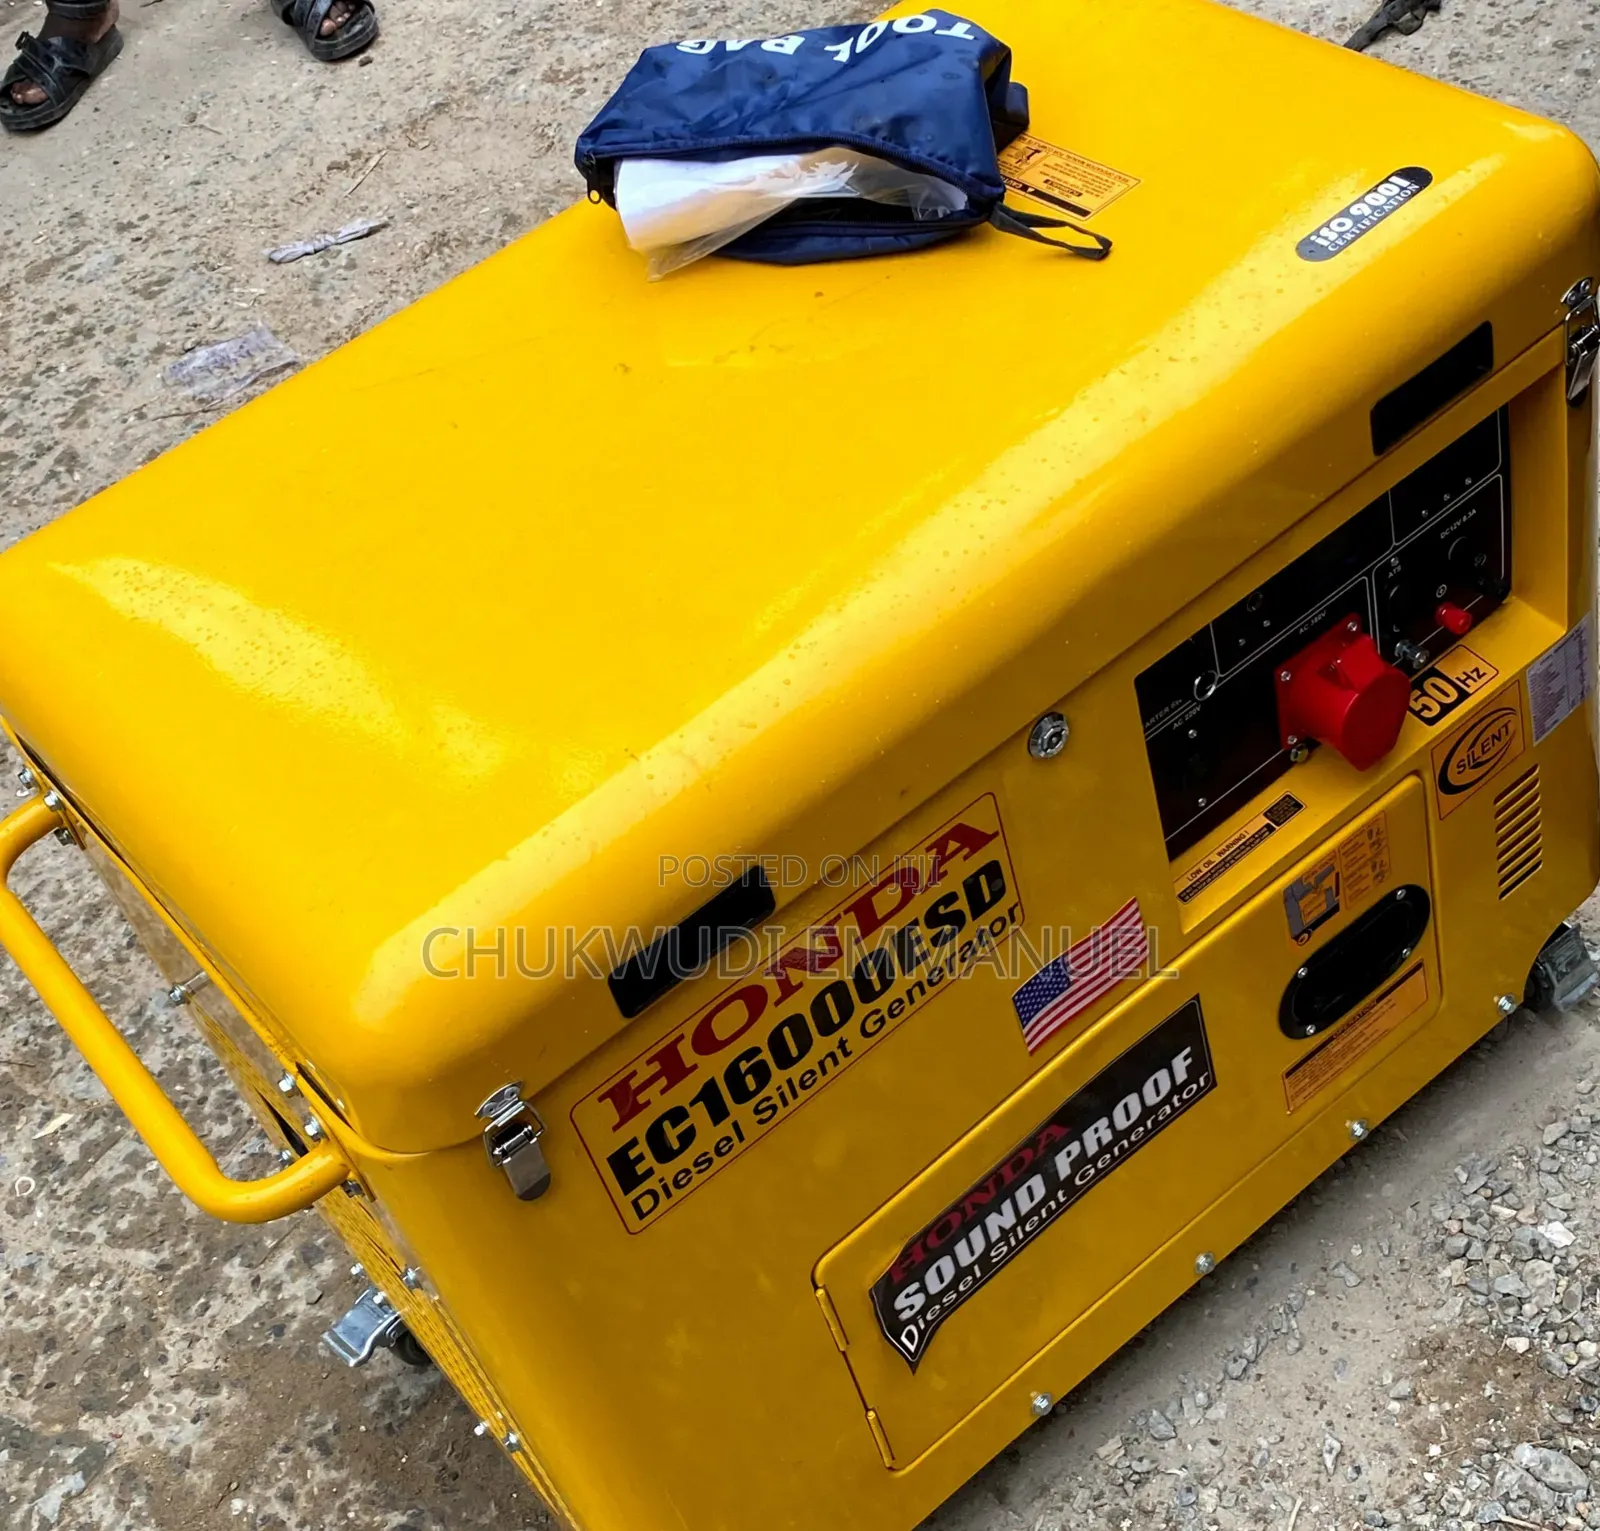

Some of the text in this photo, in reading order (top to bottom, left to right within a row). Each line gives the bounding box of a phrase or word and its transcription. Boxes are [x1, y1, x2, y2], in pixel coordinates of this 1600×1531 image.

[824, 14, 975, 63] TOOL
[1327, 183, 1420, 252] CERTIFICATION
[1350, 175, 1411, 217] 9001
[1409, 666, 1488, 718] 50 Hz
[1456, 719, 1512, 775] SILENT
[1186, 867, 1203, 882] LOW
[1203, 859, 1216, 869] OIL
[597, 822, 1000, 1134] HONDA
[606, 859, 1007, 1197] EC16000ESD
[630, 902, 1020, 1221] Diesel Silent Generator
[888, 1122, 1073, 1286] HONDA
[893, 1172, 1048, 1322] SOUND
[1053, 1045, 1194, 1182] PROOF
[900, 1071, 1210, 1354] Diesel Silent Generator
